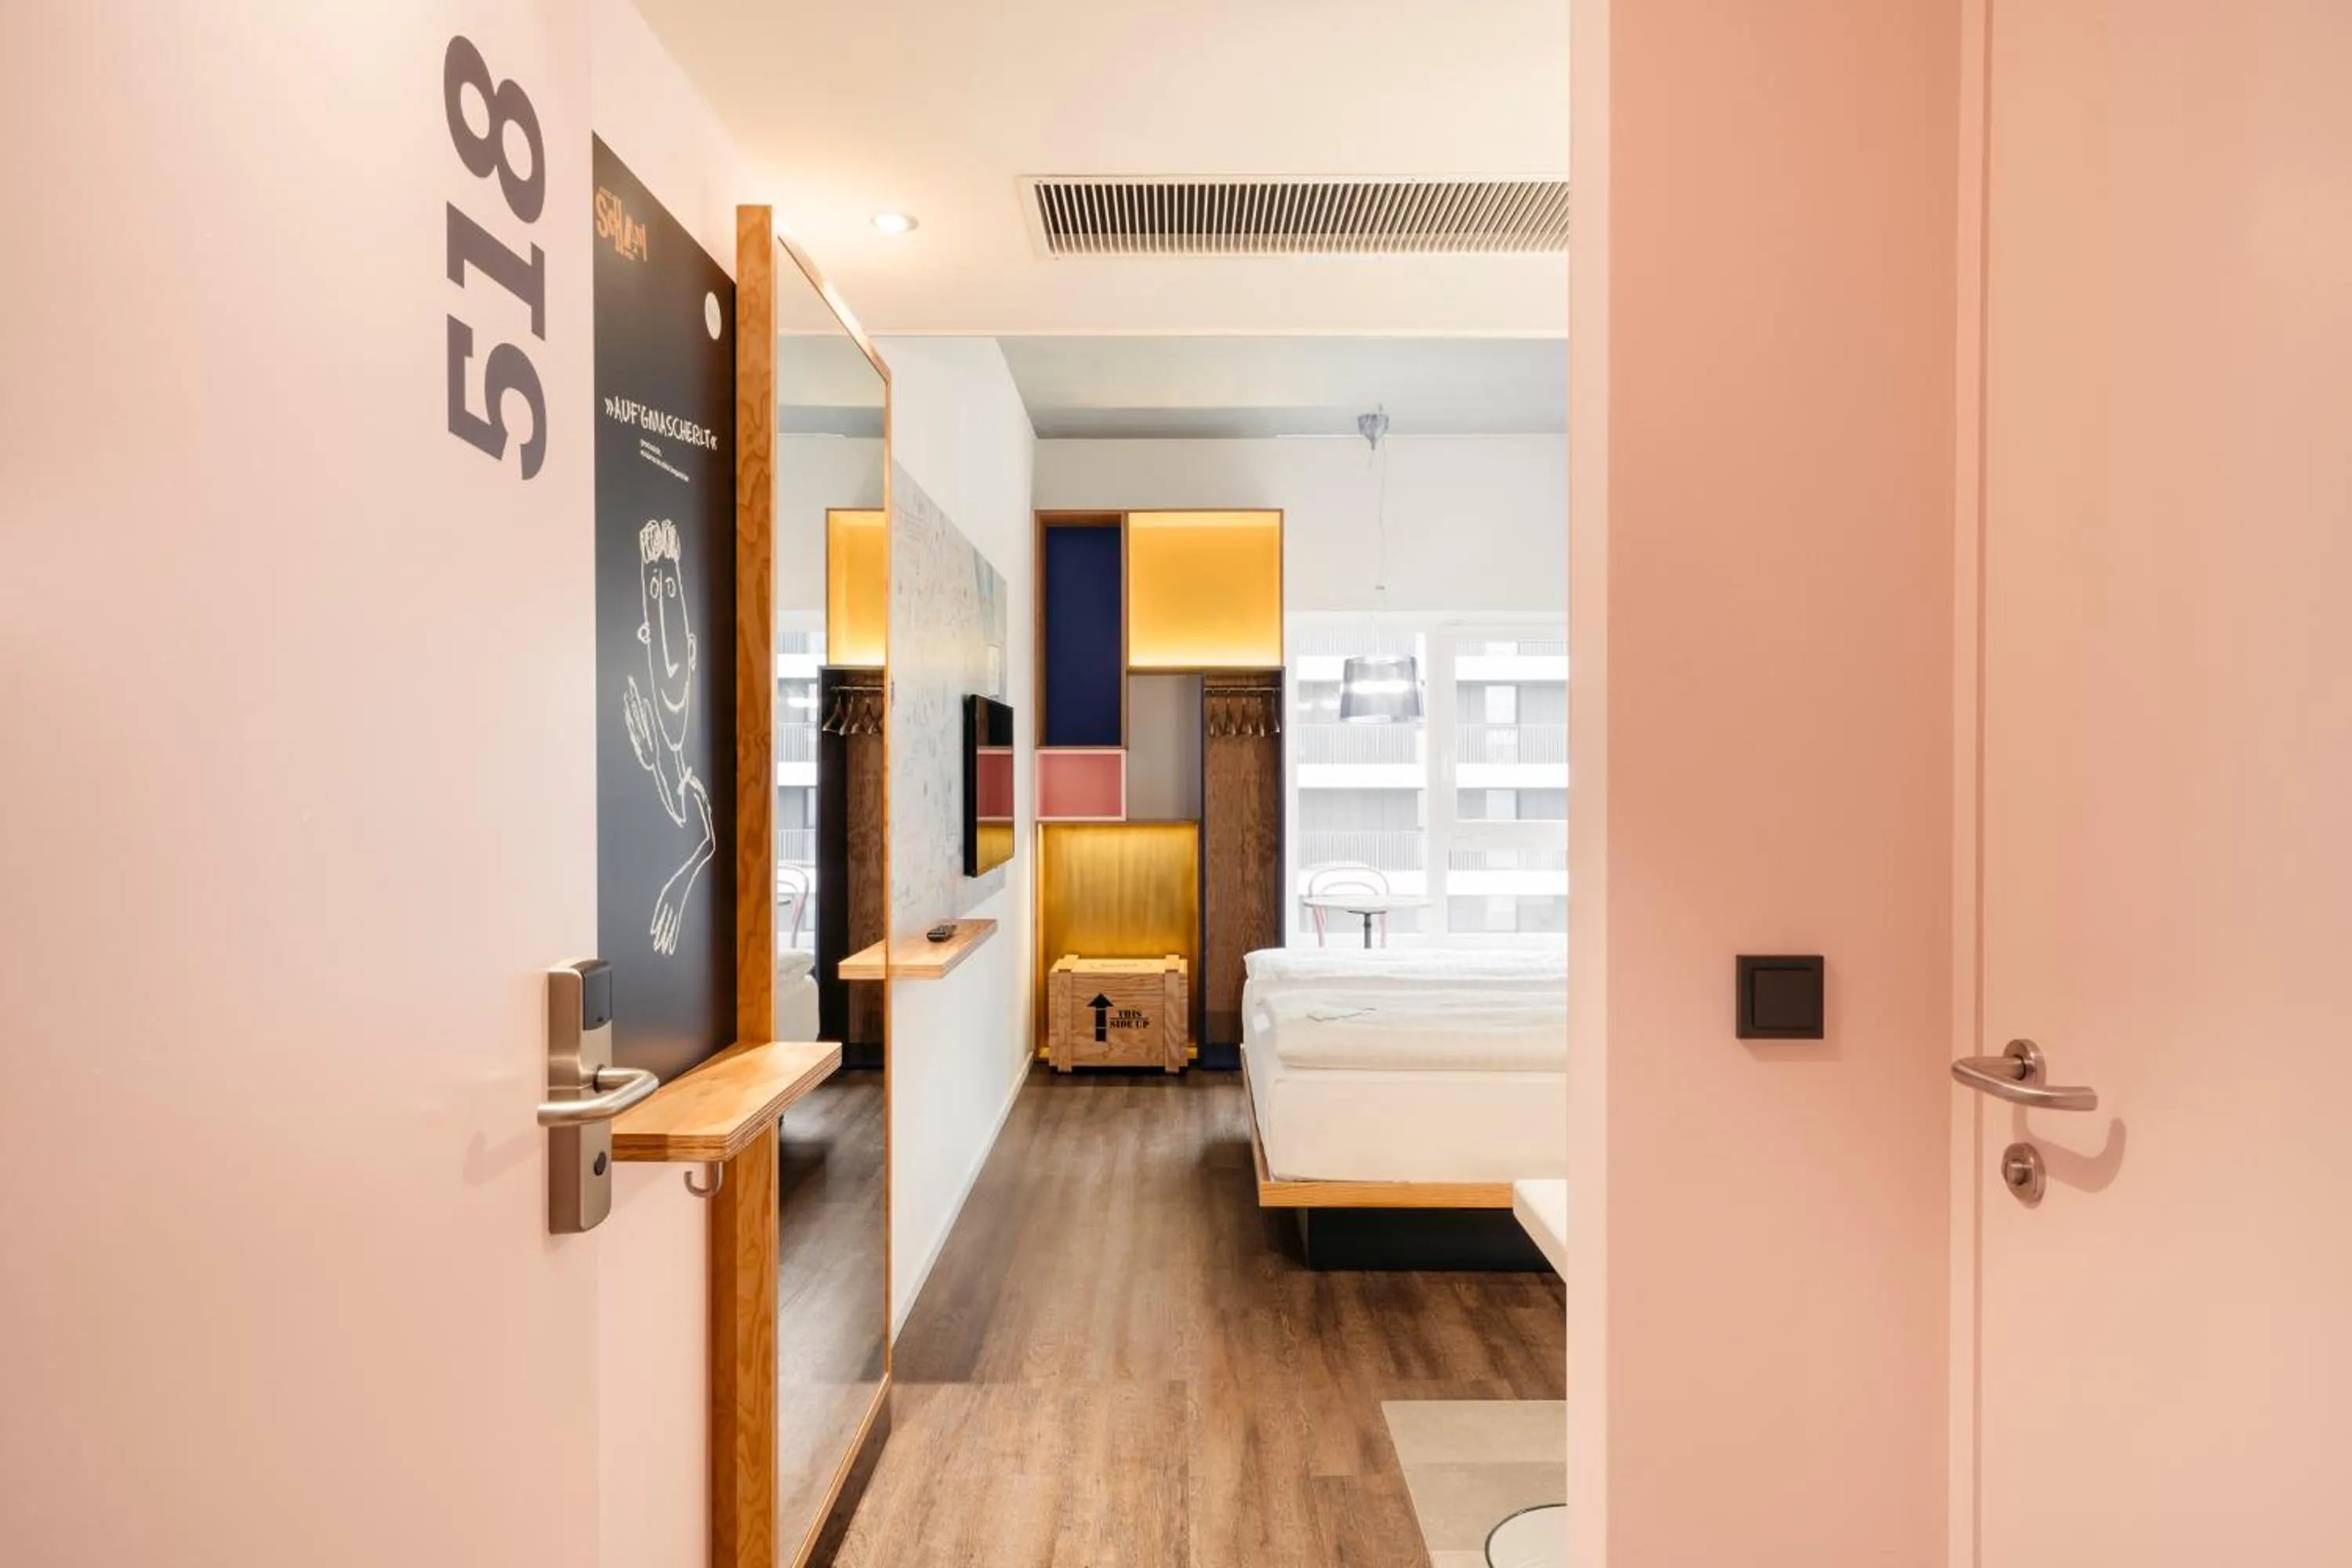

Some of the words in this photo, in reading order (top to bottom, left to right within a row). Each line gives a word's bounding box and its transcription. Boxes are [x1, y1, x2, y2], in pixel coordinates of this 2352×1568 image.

[444, 35, 546, 480] 518
[1117, 1009, 1142, 1018] THIS
[1109, 1019, 1134, 1029] SIDE
[1135, 1019, 1150, 1029] UP
